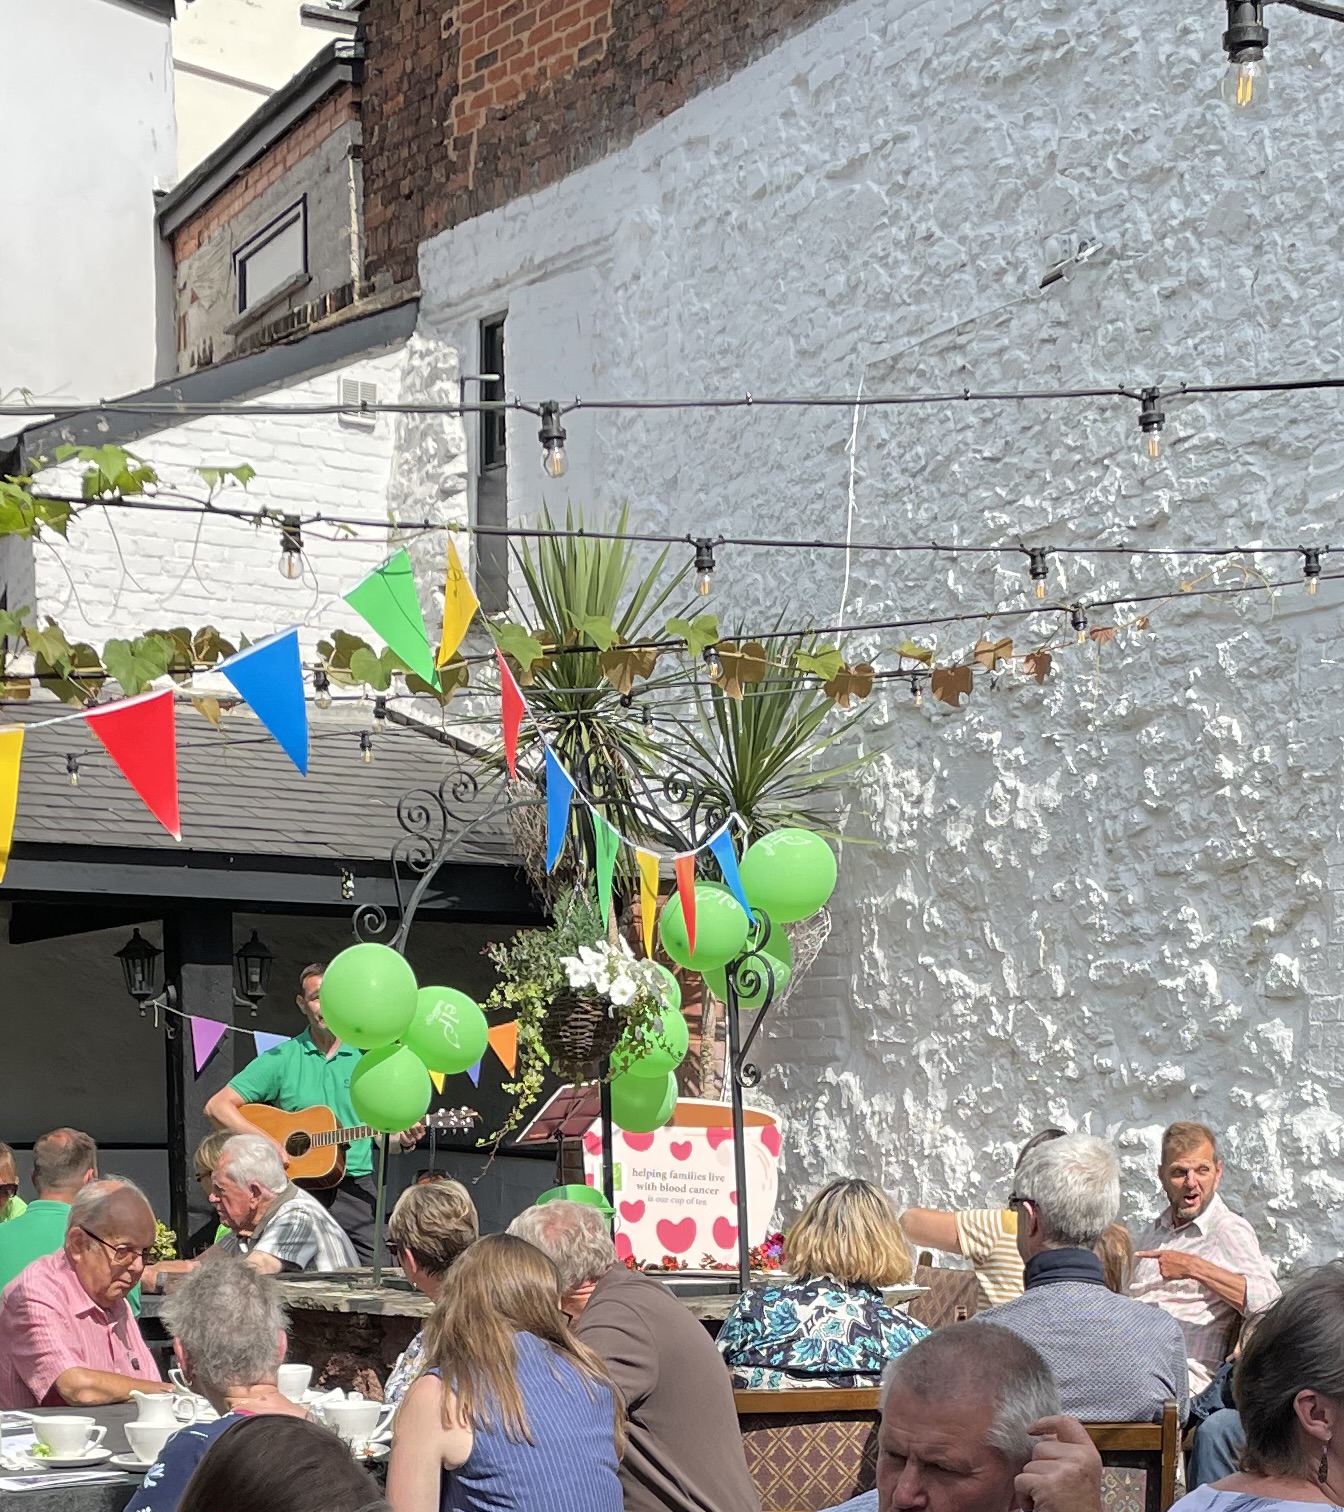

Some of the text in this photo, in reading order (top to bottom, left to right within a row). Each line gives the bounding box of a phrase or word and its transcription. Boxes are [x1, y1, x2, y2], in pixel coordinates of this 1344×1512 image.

[632, 1168, 725, 1182] helping families live
[636, 1183, 720, 1196] with blood cancer
[670, 1197, 685, 1205] cup
